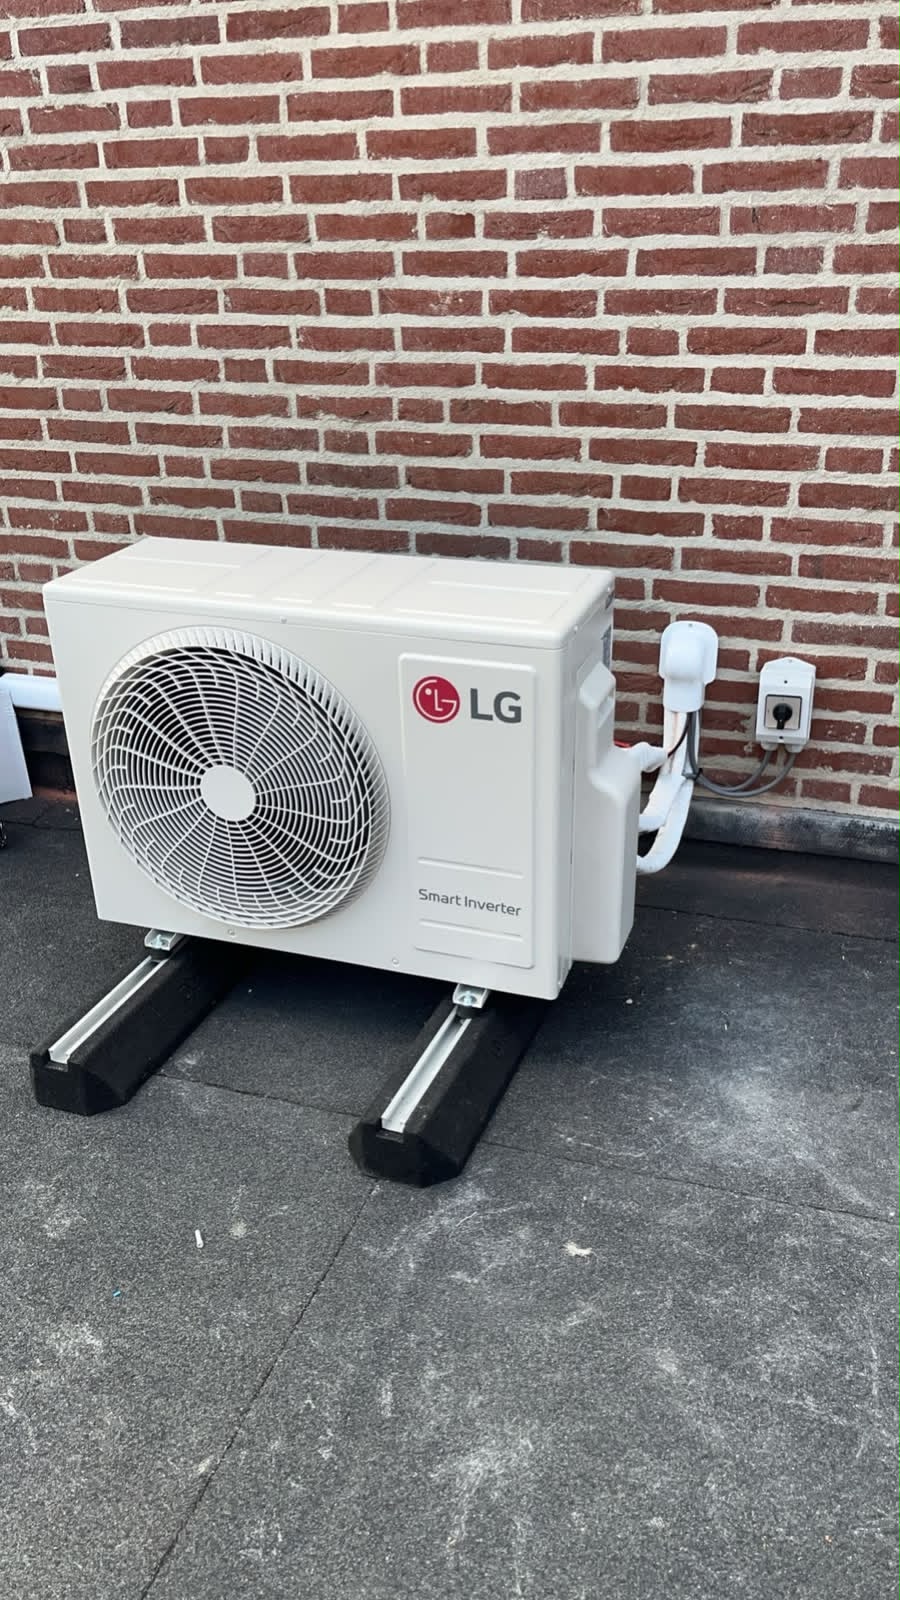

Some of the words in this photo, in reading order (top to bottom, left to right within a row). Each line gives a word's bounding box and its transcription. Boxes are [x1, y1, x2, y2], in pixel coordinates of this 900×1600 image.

[470, 688, 522, 724] LG
[418, 888, 461, 906] Smart
[464, 896, 522, 916] Inverter
